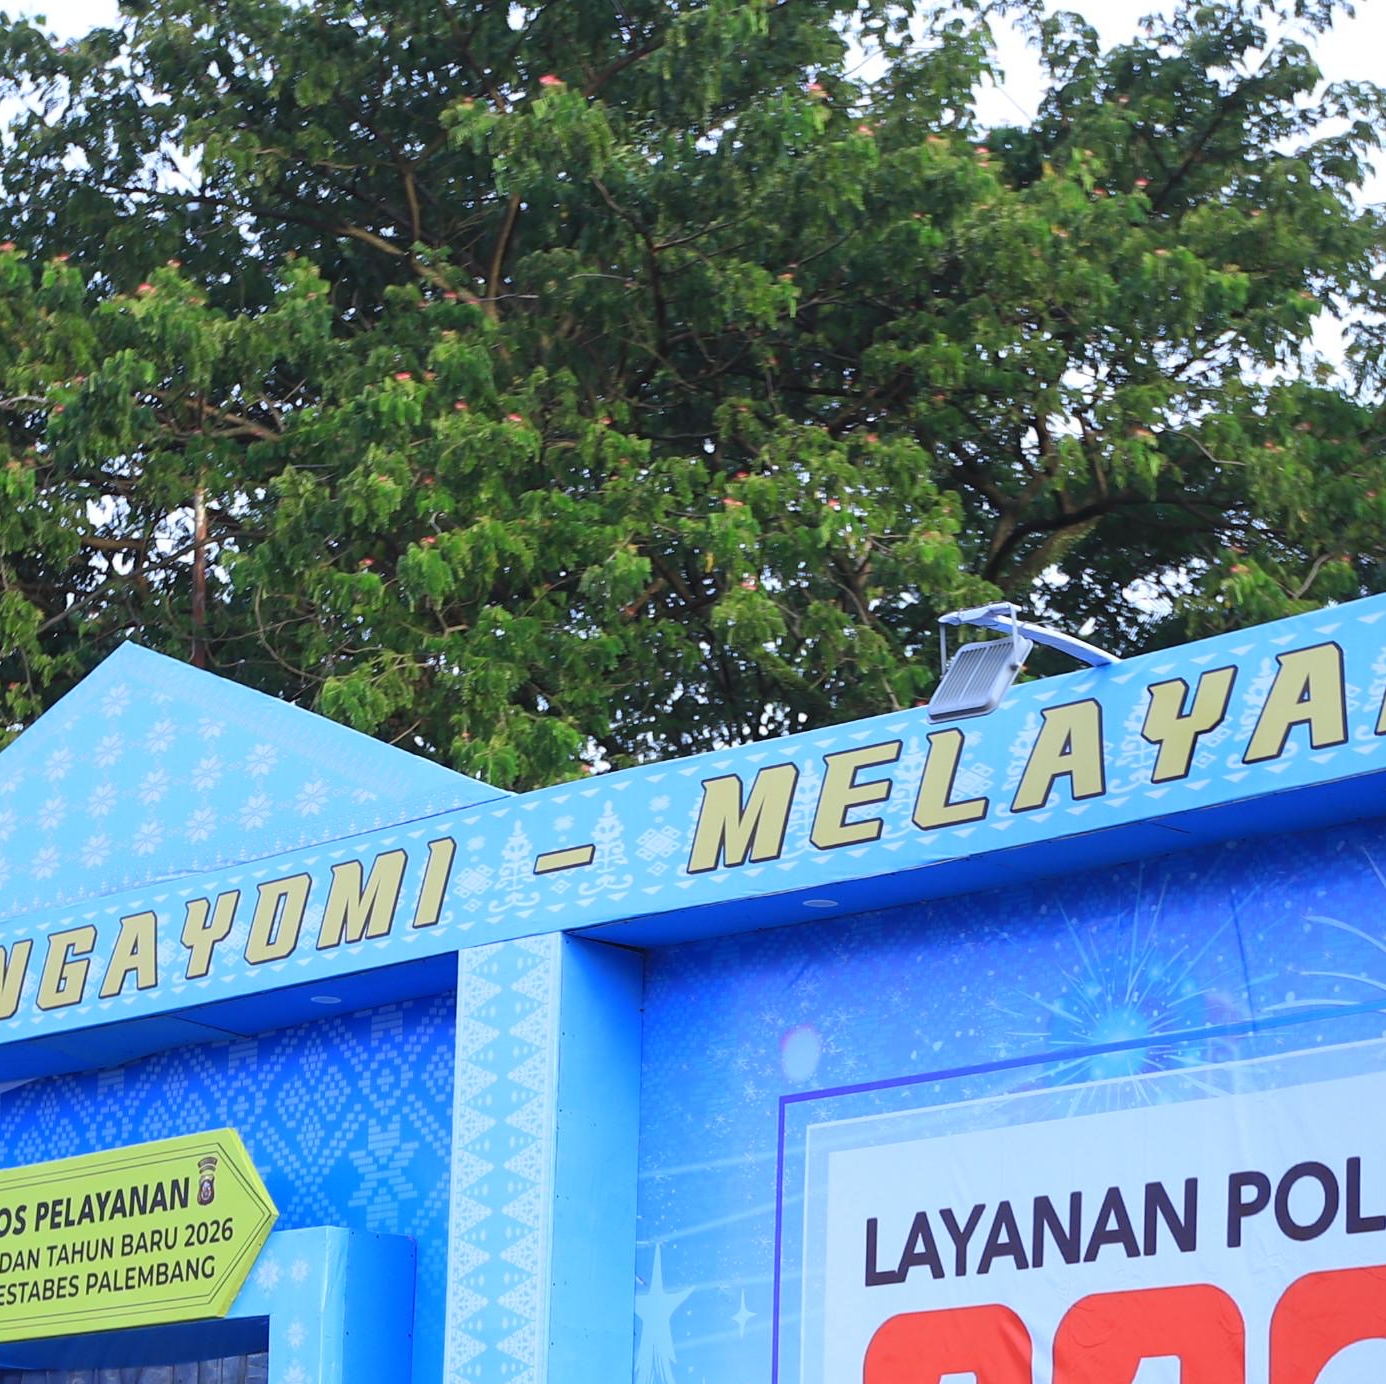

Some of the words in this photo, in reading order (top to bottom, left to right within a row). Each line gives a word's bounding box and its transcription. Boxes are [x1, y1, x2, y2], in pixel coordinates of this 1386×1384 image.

[34, 1177, 190, 1232] PELAYANAN
[47, 1237, 113, 1267] TAHUN
[121, 1226, 178, 1257] BARU
[184, 1217, 234, 1247] 2026
[863, 1176, 1199, 1287] LAYANAN
[85, 1255, 215, 1295] PALEMBANG
